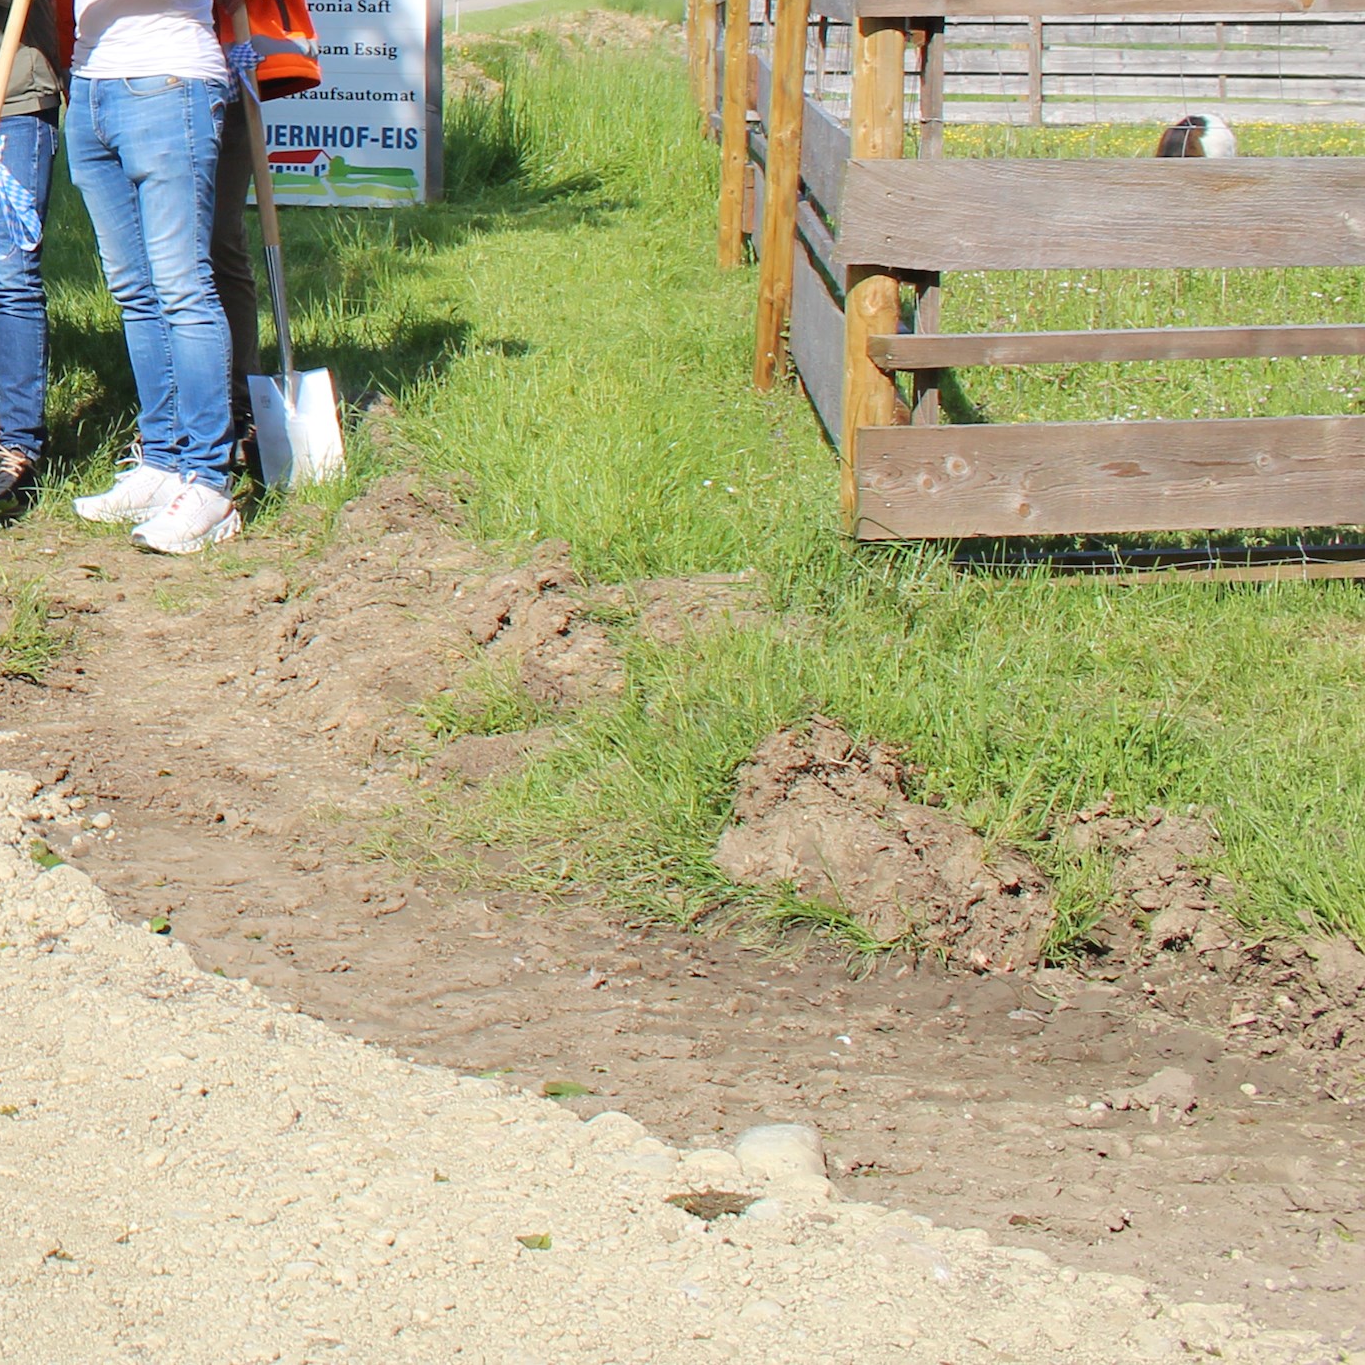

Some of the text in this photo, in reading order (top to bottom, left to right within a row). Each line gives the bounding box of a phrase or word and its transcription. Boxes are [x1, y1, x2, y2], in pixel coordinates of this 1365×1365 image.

[307, 0, 391, 13] ronia Saft
[317, 42, 398, 60] sam Essig
